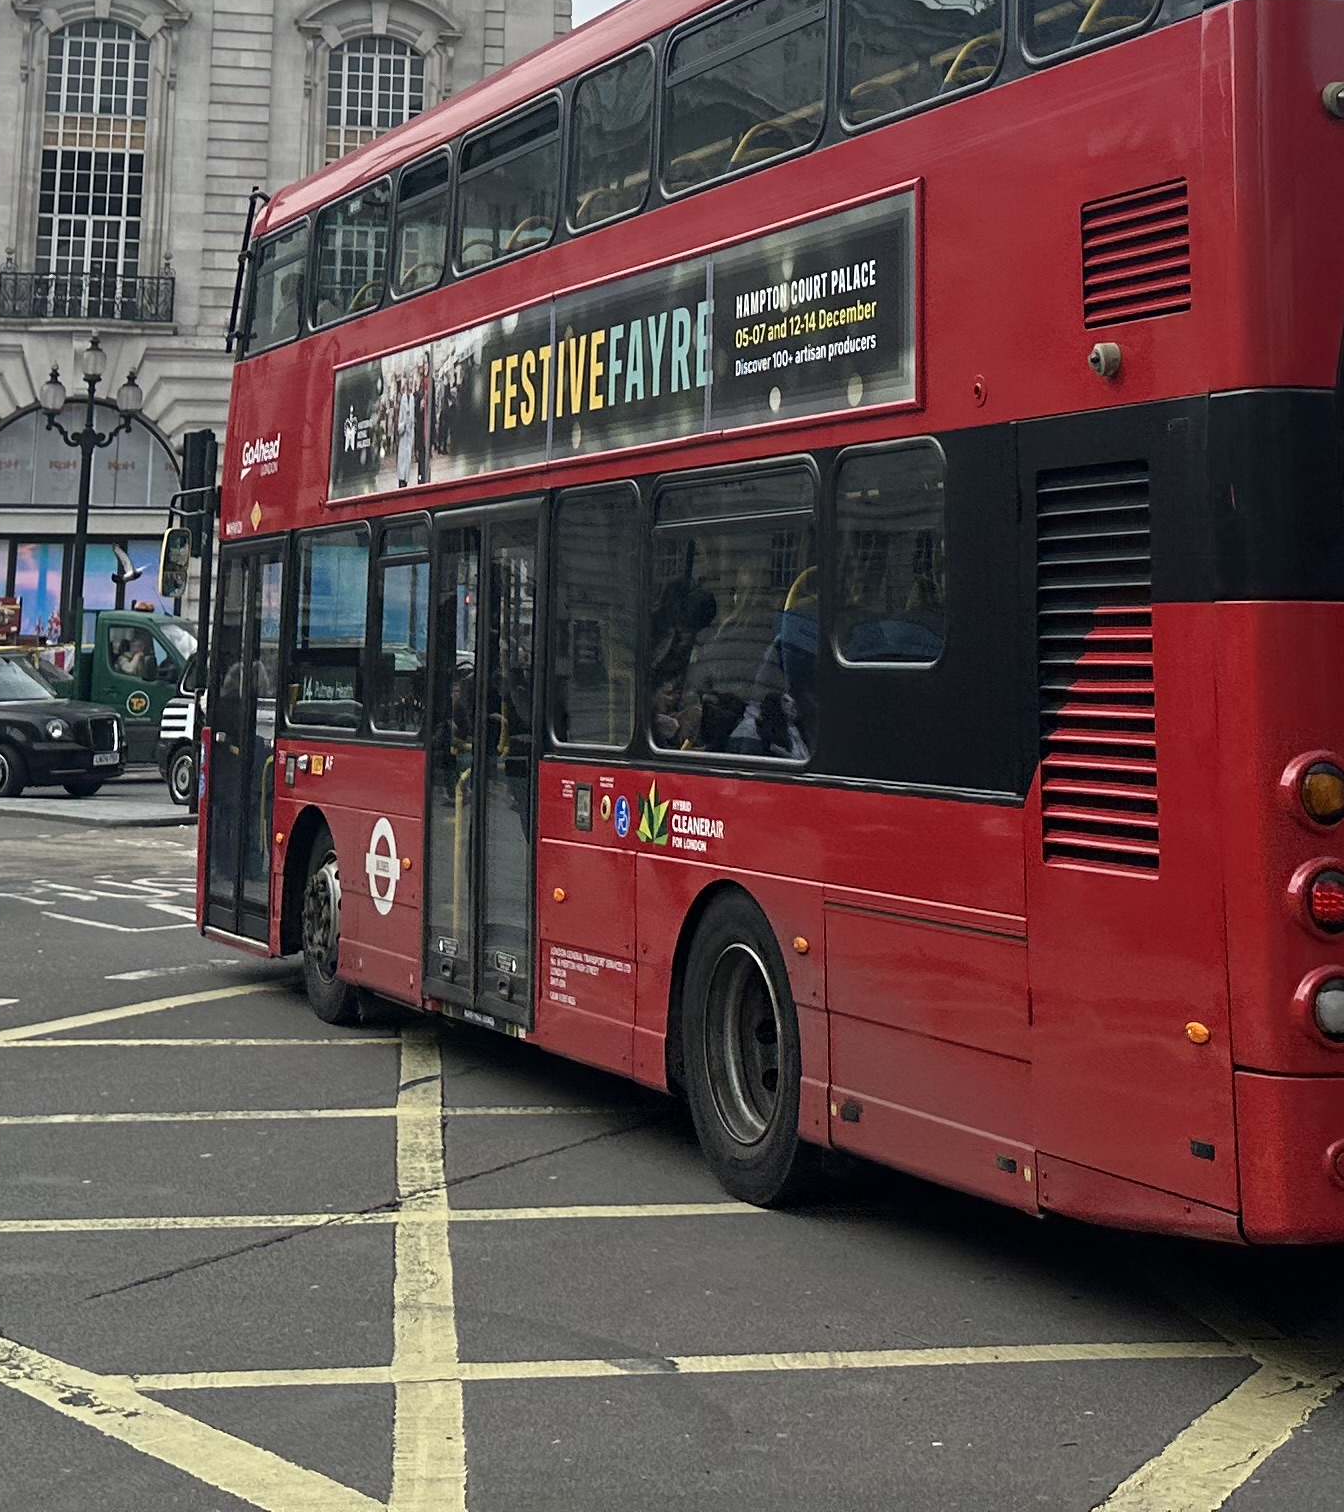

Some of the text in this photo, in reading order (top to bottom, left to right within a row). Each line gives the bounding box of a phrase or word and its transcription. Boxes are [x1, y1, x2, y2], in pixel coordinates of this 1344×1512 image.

[735, 260, 876, 319] HAMPTON COURT PALACE
[735, 299, 877, 348] 05-07 and 12-14 December
[735, 334, 877, 377] Discover 100+ artisan producers
